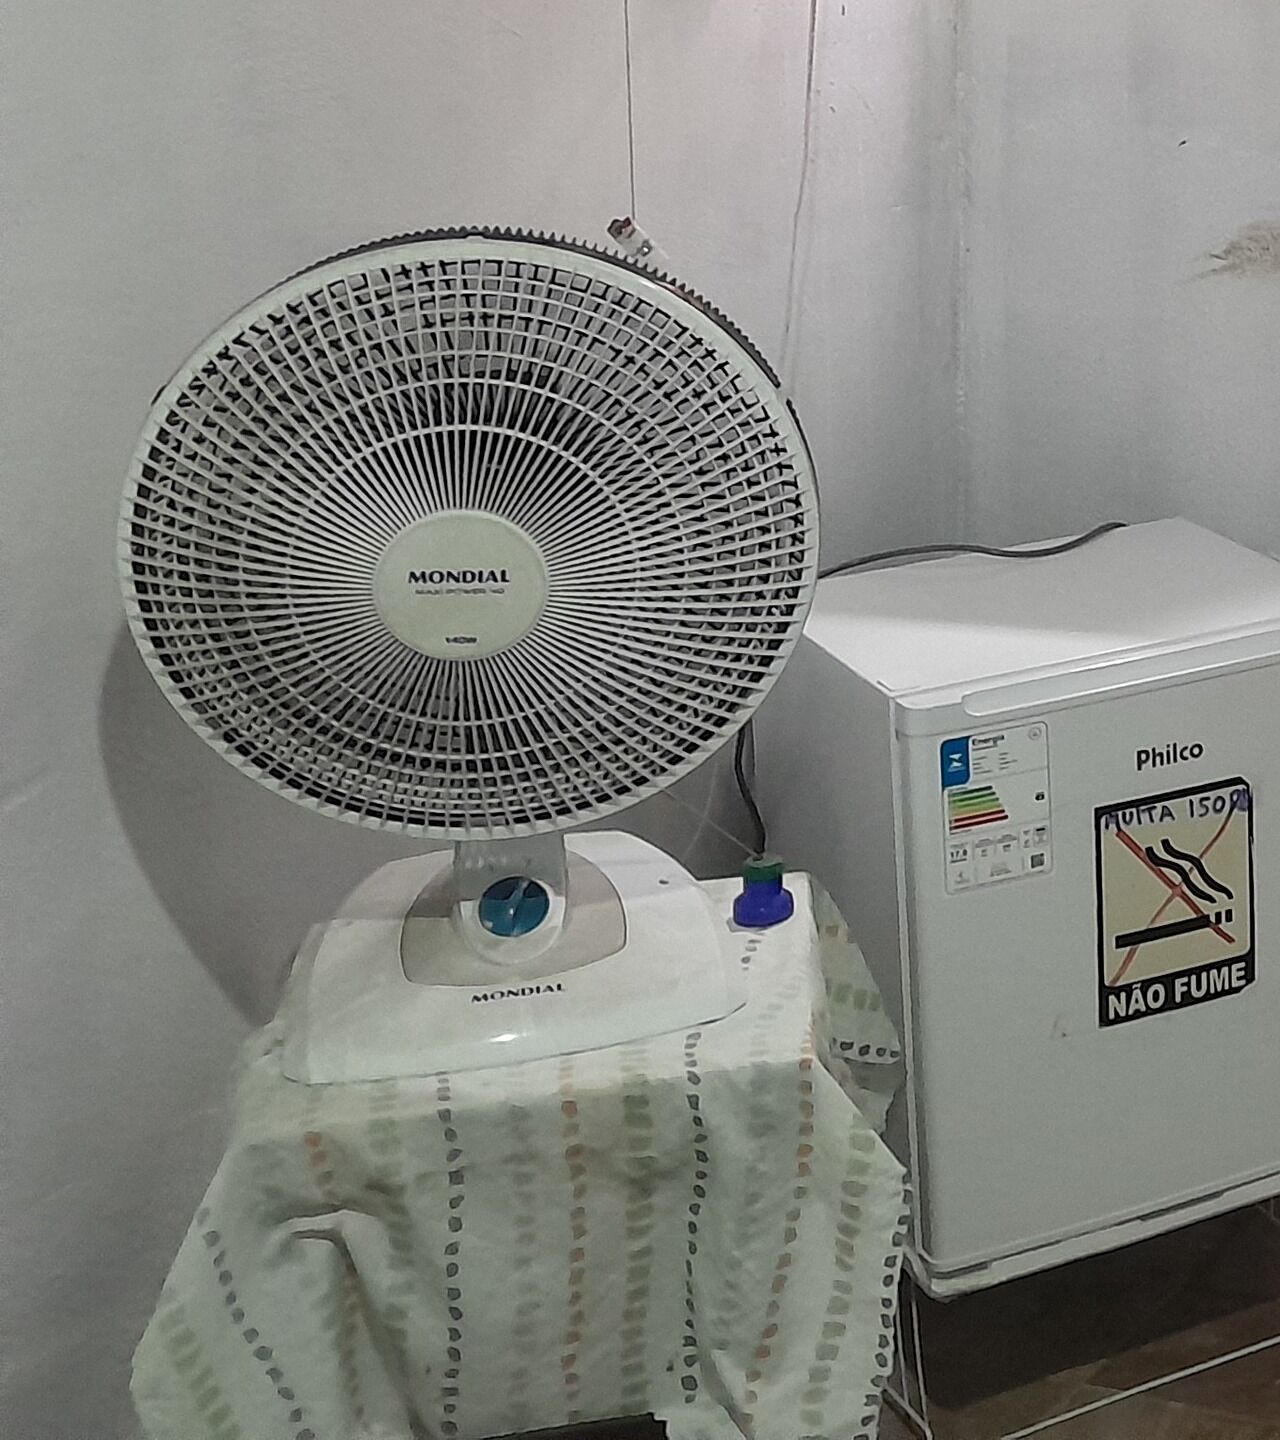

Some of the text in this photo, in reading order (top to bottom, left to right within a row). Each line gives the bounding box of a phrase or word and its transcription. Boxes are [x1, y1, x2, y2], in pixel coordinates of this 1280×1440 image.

[408, 569, 511, 584] MONDIAL
[1136, 742, 1204, 771] Philco
[471, 983, 567, 1003] MONDIAL
[1107, 961, 1247, 1020] NÃO FUME
